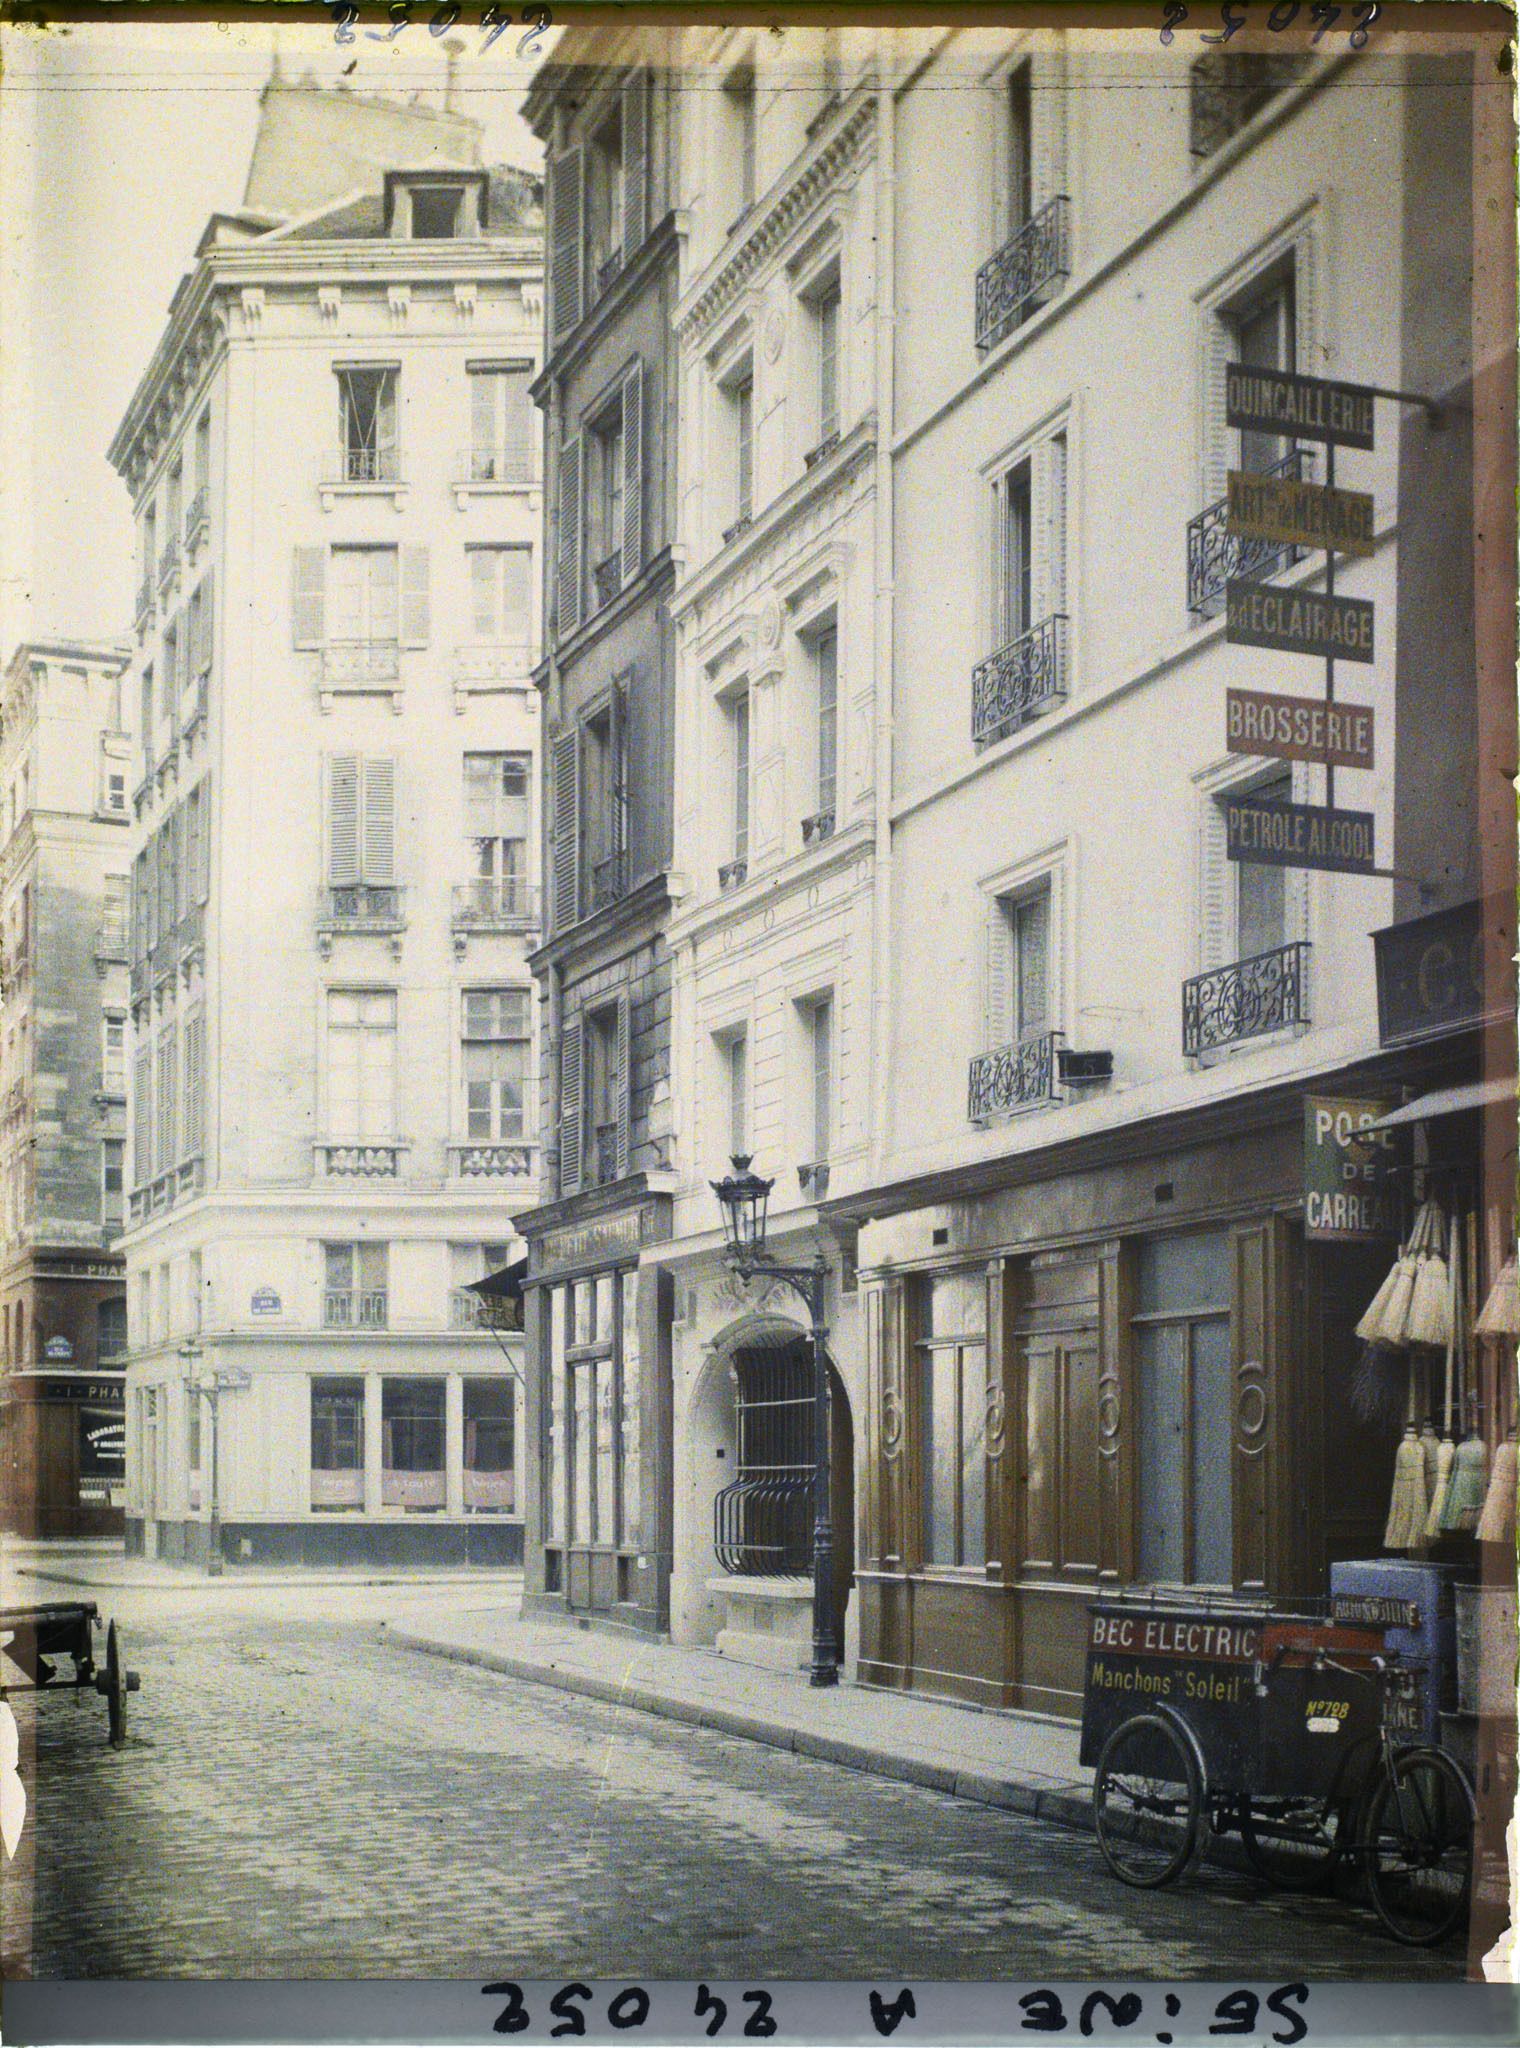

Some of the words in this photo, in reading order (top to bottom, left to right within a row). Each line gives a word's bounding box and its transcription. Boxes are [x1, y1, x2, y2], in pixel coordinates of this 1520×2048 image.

[1230, 700, 1369, 754] BROSSERIE
[1229, 807, 1305, 853] PETROLE
[1308, 817, 1373, 860] ALCOOL
[1342, 1162, 1376, 1182] DE
[88, 1385, 125, 1399] PHA
[1093, 1616, 1134, 1647] BEC
[1145, 1621, 1256, 1658] ELECTRIC
[1092, 1662, 1172, 1695] Manchons
[869, 1988, 916, 2037] A
